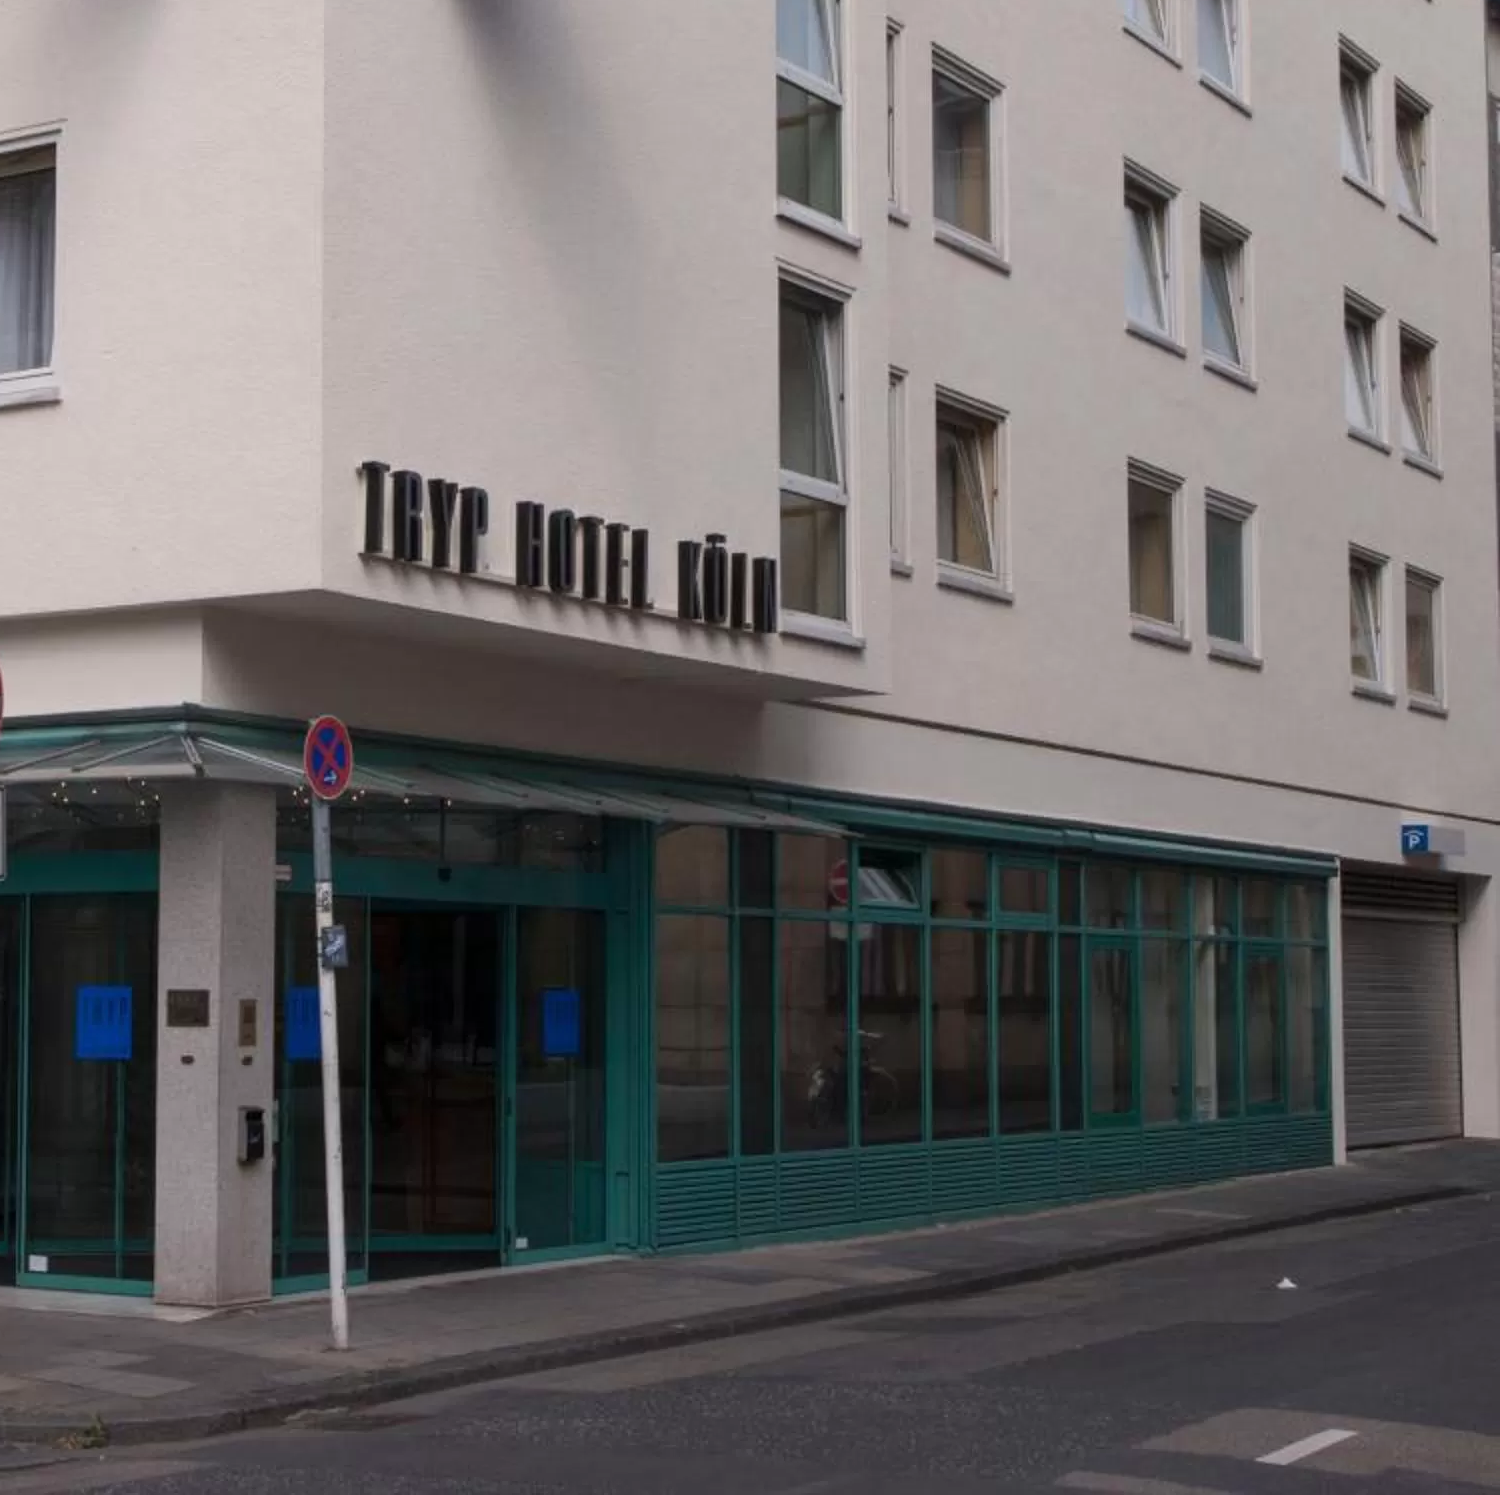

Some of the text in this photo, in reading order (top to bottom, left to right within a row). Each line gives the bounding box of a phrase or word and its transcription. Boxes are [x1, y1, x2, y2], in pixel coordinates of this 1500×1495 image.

[360, 460, 777, 633] TRYP HOTEL KÖLN
